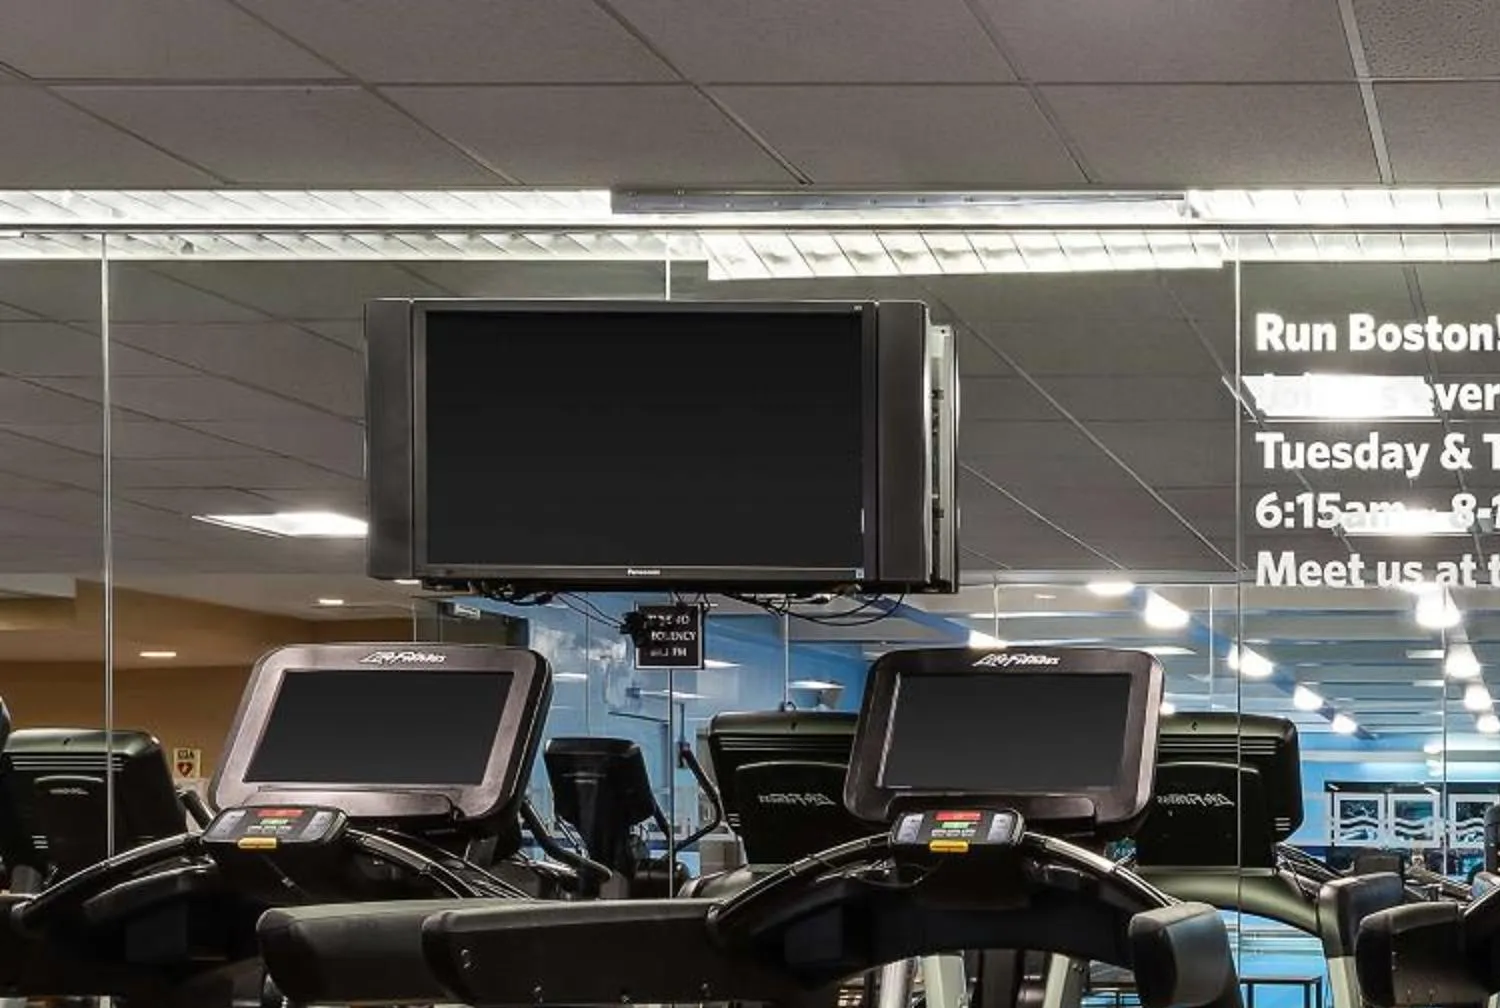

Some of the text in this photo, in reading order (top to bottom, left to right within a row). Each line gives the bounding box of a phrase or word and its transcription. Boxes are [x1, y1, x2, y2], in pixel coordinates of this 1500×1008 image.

[1255, 313, 1336, 351] Run
[1255, 431, 1429, 478] Tuesday
[1440, 432, 1472, 470] &
[1255, 551, 1365, 588] Meet
[1377, 560, 1424, 588] us
[1434, 554, 1476, 588] at
